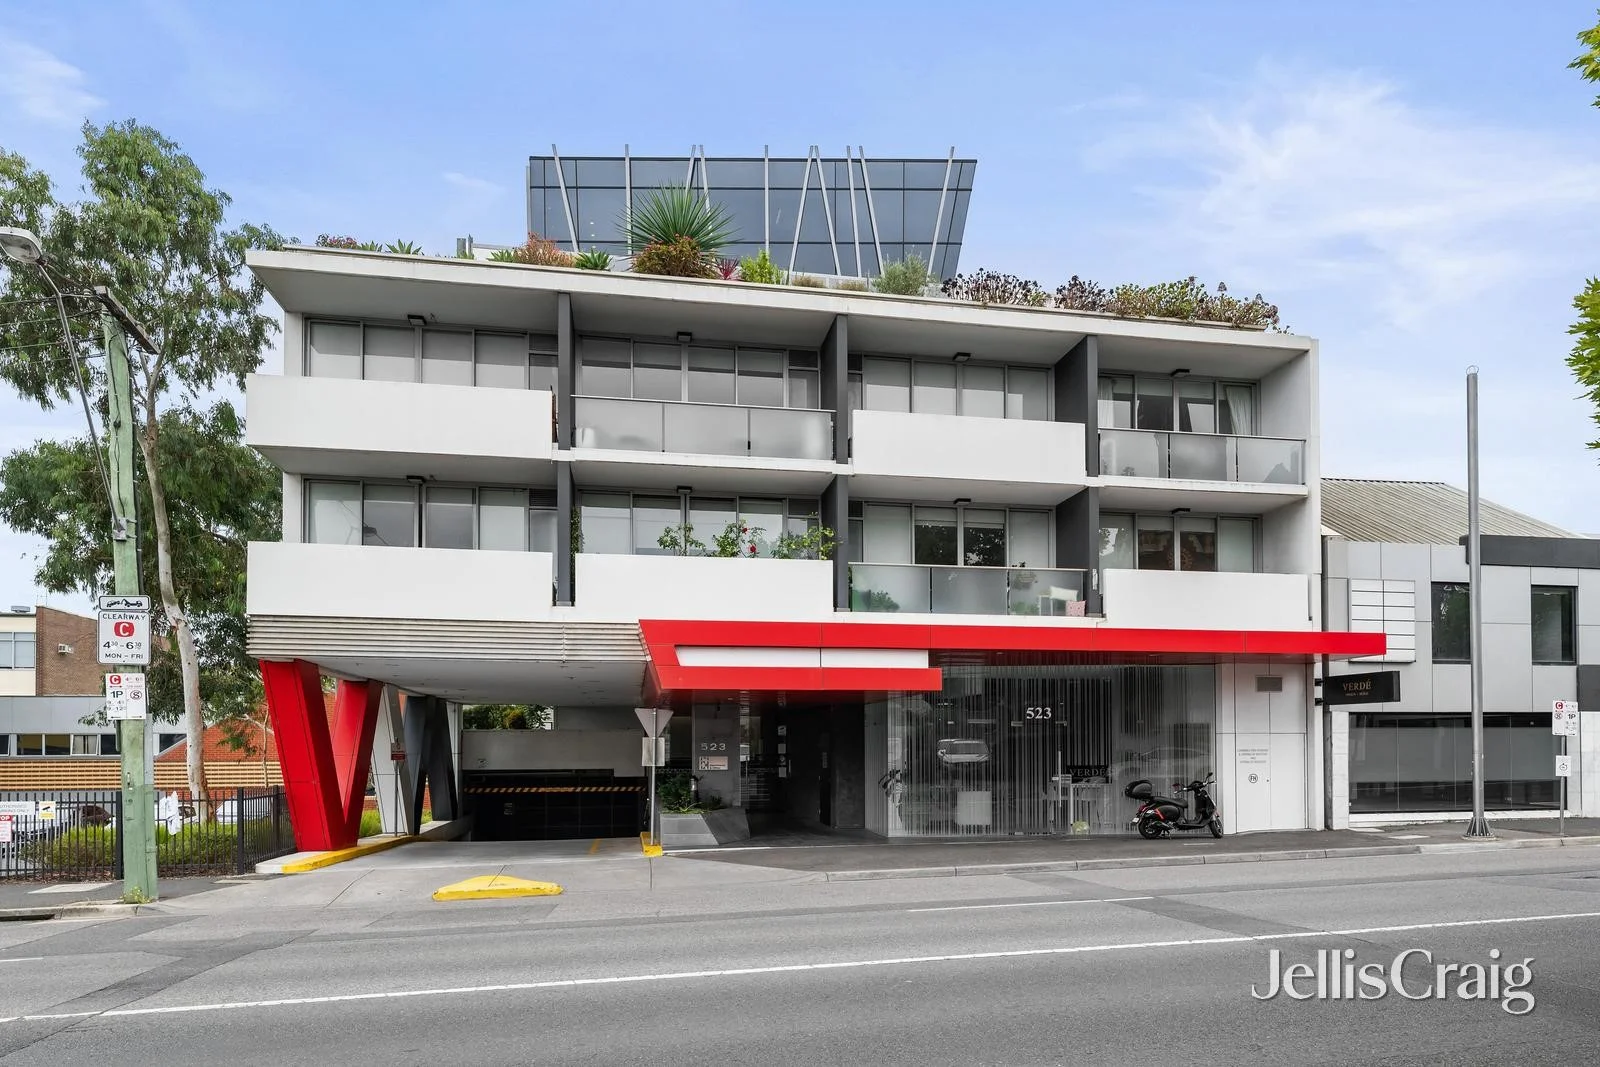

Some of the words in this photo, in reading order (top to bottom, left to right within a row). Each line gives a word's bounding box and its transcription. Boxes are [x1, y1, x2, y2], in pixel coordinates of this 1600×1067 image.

[102, 613, 146, 621] CLEARWAY
[111, 690, 124, 699] 1P
[1026, 707, 1052, 720] 523
[701, 743, 726, 751] 523
